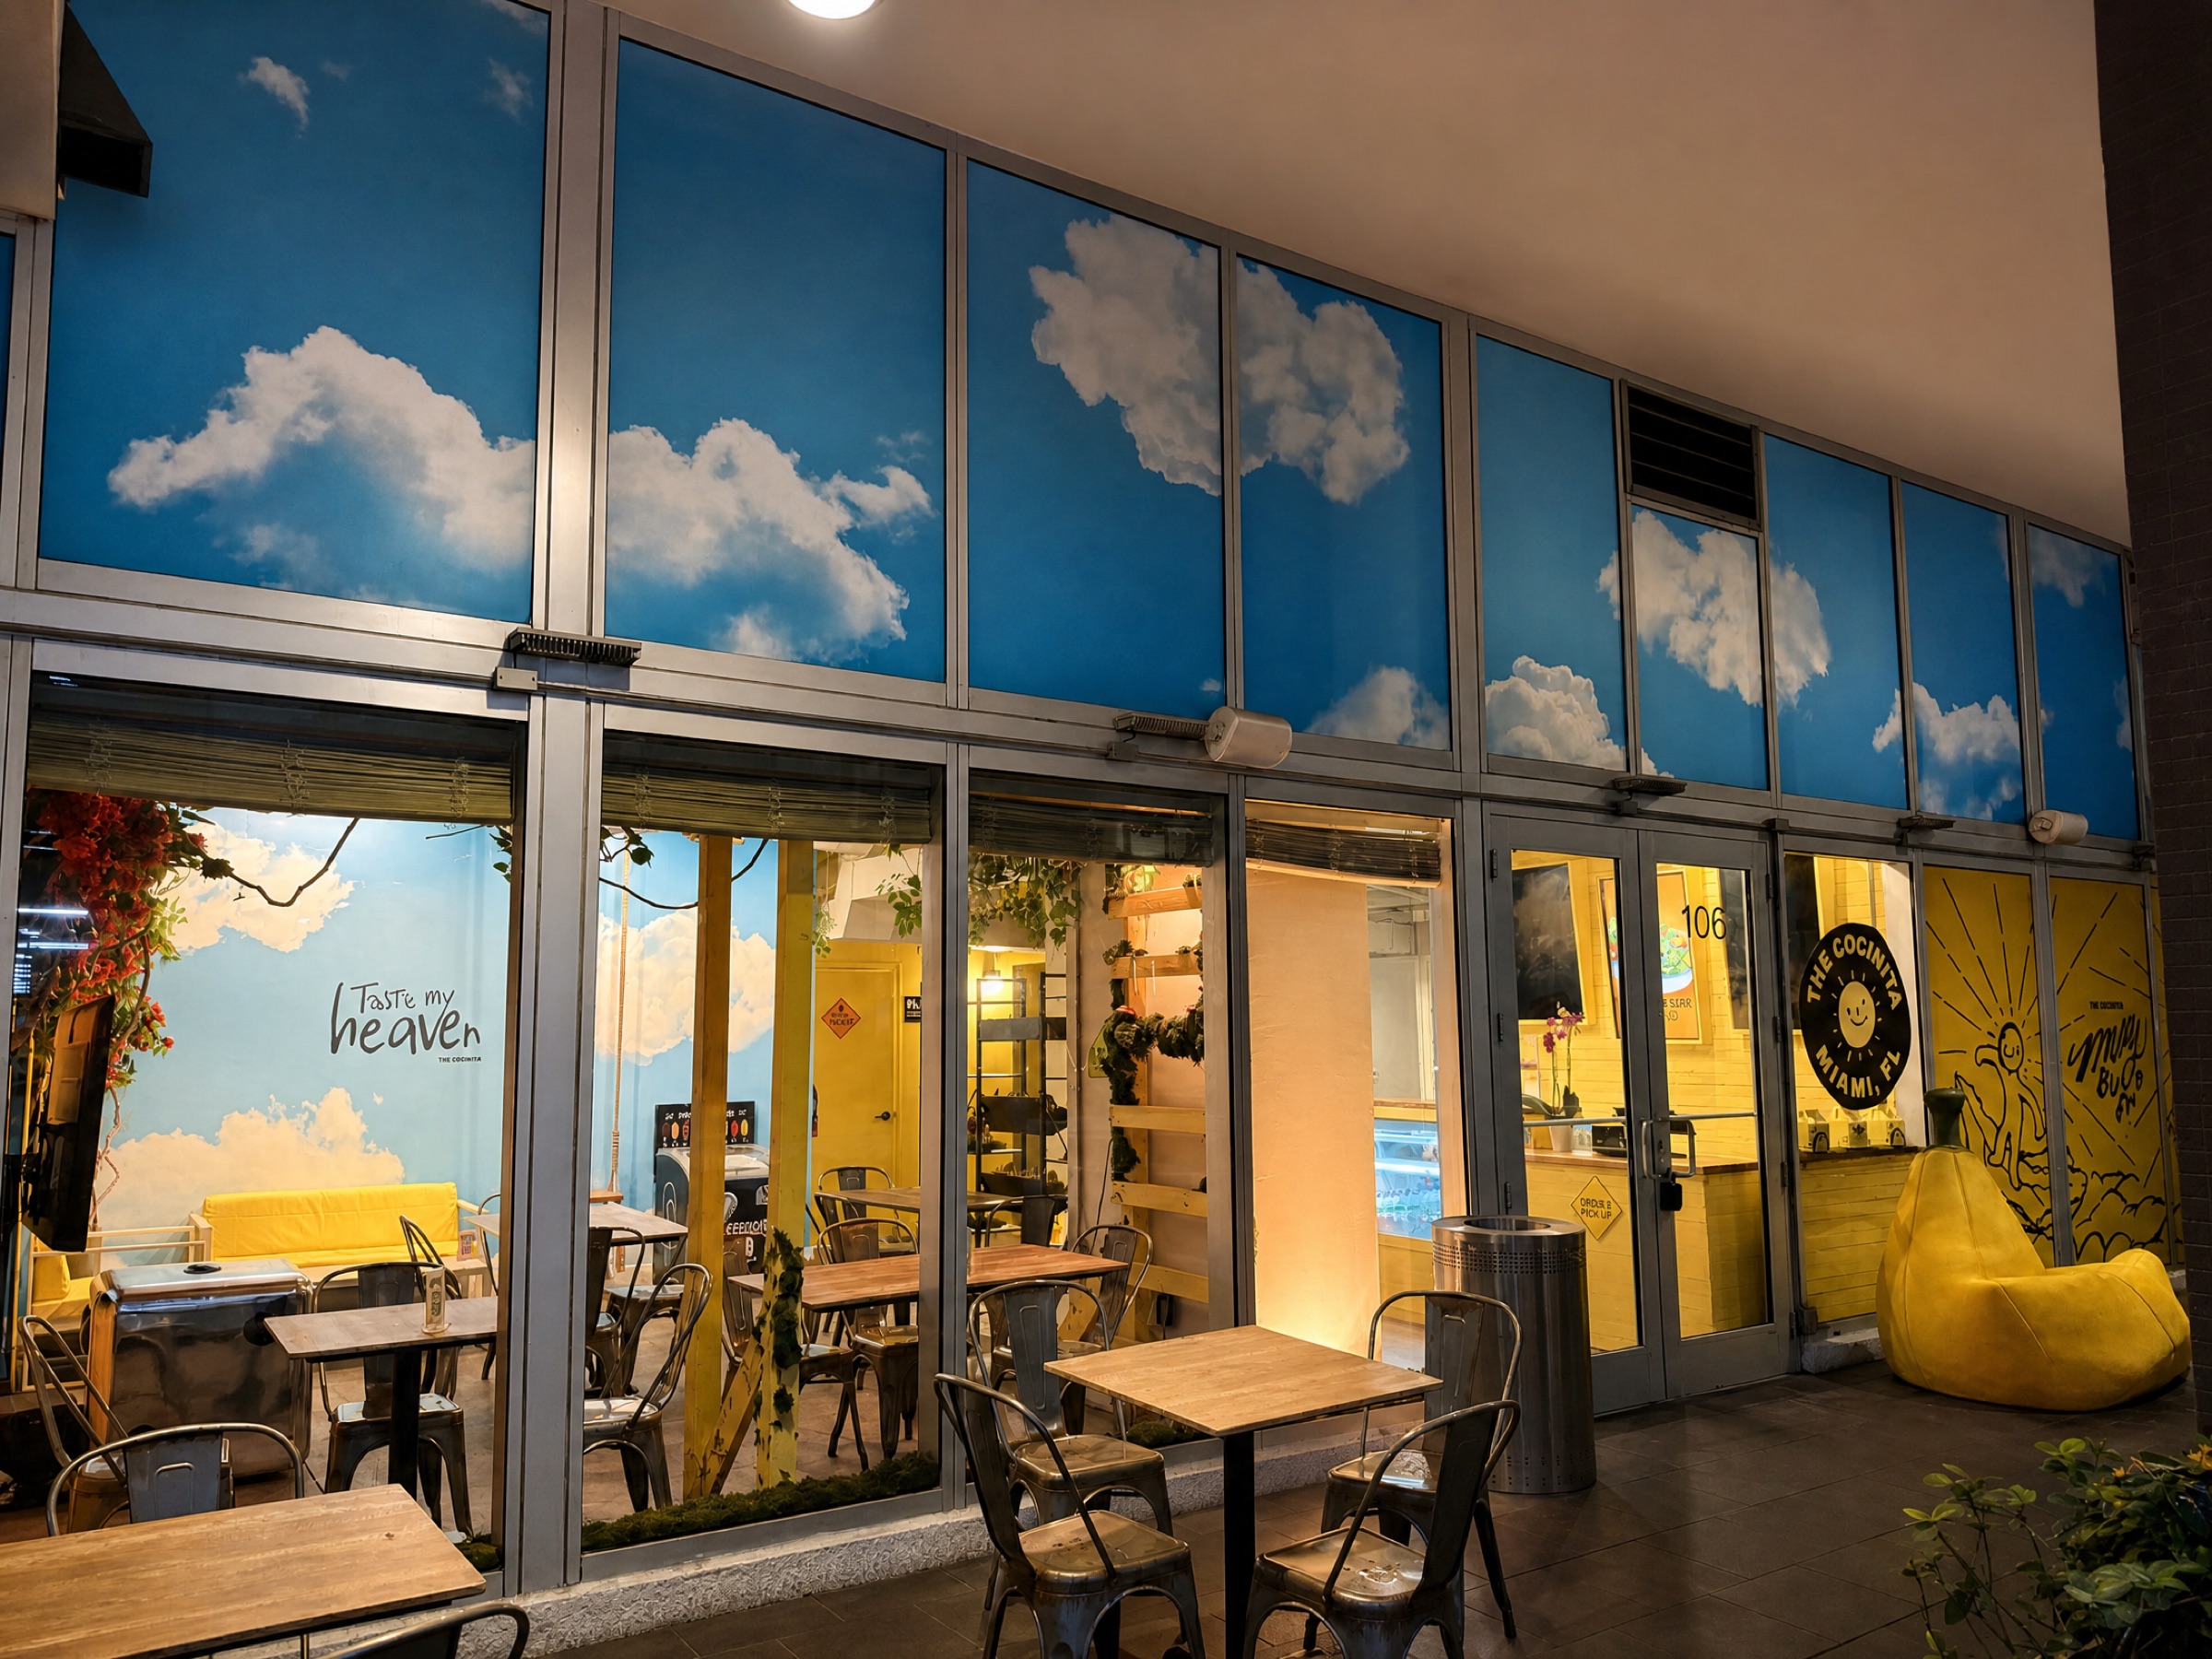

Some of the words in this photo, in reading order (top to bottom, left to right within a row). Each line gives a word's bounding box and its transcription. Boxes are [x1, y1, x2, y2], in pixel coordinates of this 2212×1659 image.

[1681, 905, 1727, 939] 106
[1806, 949, 1833, 1003] THE
[1832, 934, 1902, 1010] COCINITA
[331, 982, 481, 1055] heaven
[1816, 1044, 1880, 1098] MIAMI,
[1879, 1051, 1901, 1081] FL
[1600, 1210, 1612, 1219] UP
